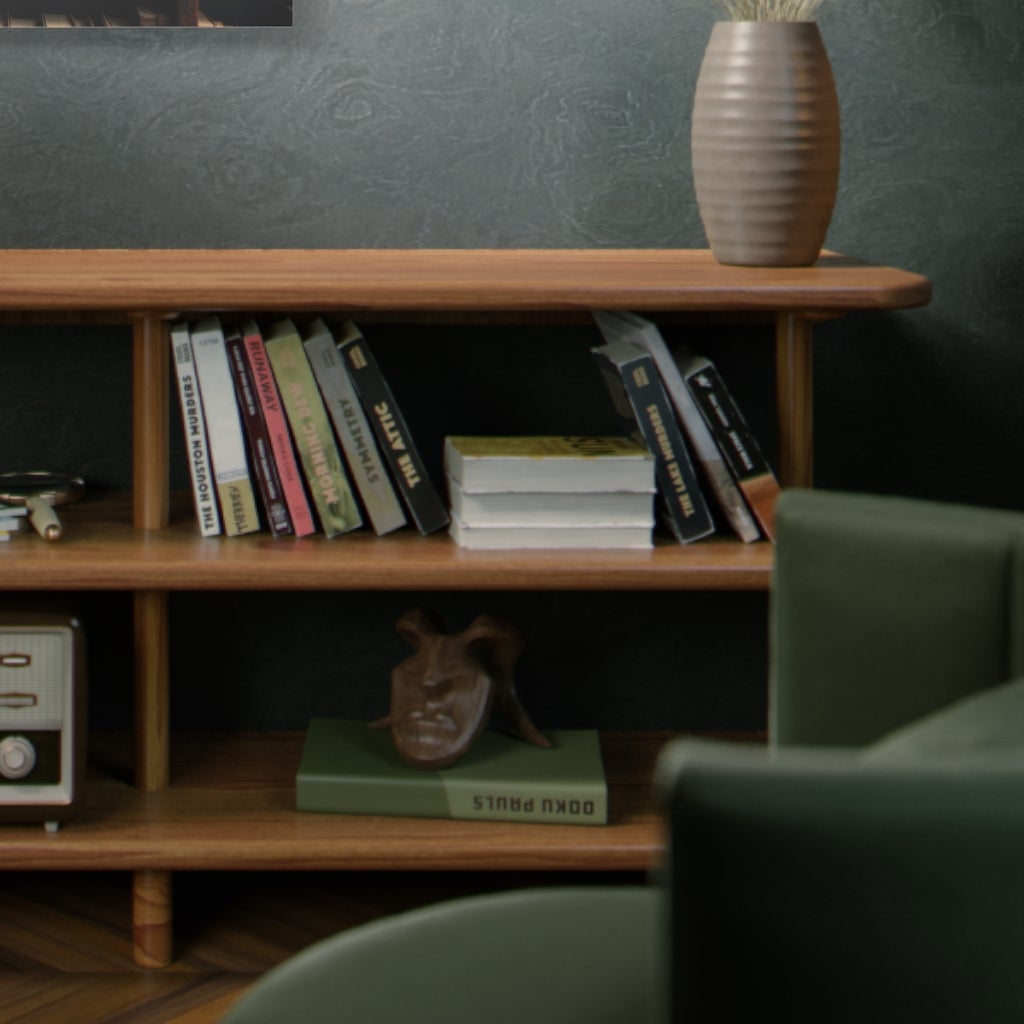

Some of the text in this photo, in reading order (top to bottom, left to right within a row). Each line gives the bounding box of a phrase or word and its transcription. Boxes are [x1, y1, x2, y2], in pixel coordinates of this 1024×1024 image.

[182, 375, 201, 436] MURDERS
[249, 341, 278, 412] RUNAWAY
[288, 382, 312, 420] DEW
[338, 399, 380, 484] SYMMETRY
[373, 401, 421, 489] THE ATTIC
[646, 403, 675, 461] MURDERS
[191, 440, 210, 502] HOUSTON
[302, 422, 339, 504] MORNING
[201, 506, 215, 530] THE
[678, 492, 695, 519] THE
[473, 795, 595, 816] DOKU PAULS
